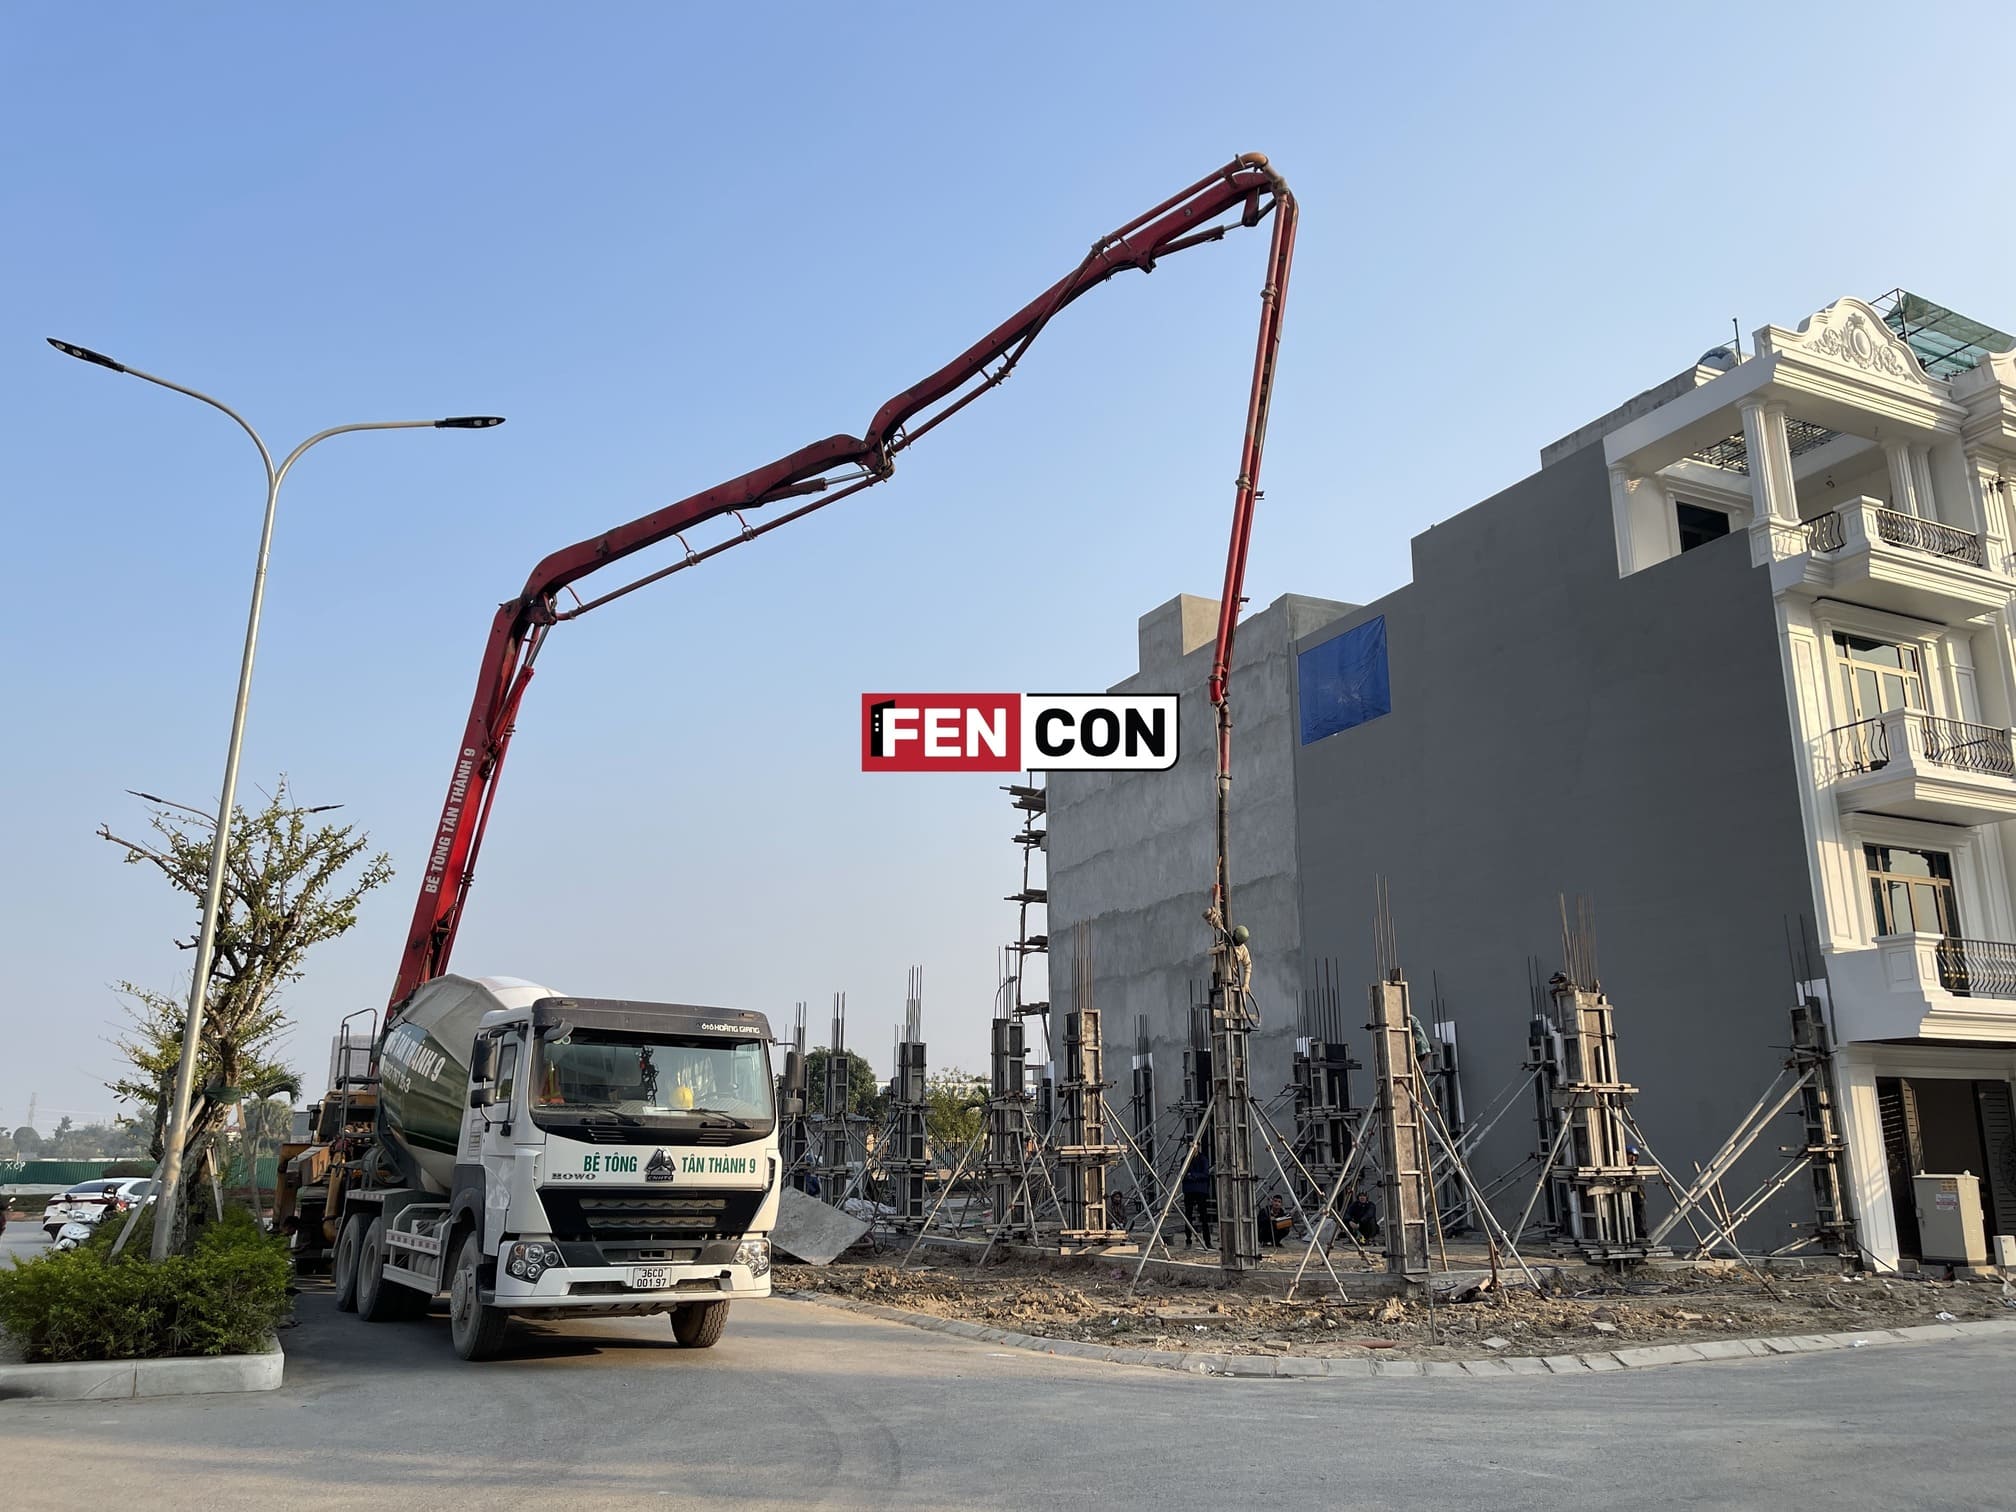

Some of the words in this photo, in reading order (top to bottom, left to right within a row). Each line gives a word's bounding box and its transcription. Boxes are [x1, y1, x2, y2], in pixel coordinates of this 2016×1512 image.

[450, 759, 473, 803] THÀNH
[463, 748, 476, 757] 9
[430, 1056, 446, 1082] 9
[583, 1152, 601, 1172] BÊ
[604, 1152, 638, 1173] TÔNG
[681, 1153, 705, 1173] TÂN
[708, 1153, 746, 1174] THÀNH
[749, 1158, 756, 1174] 9
[551, 1172, 597, 1181] HOWO
